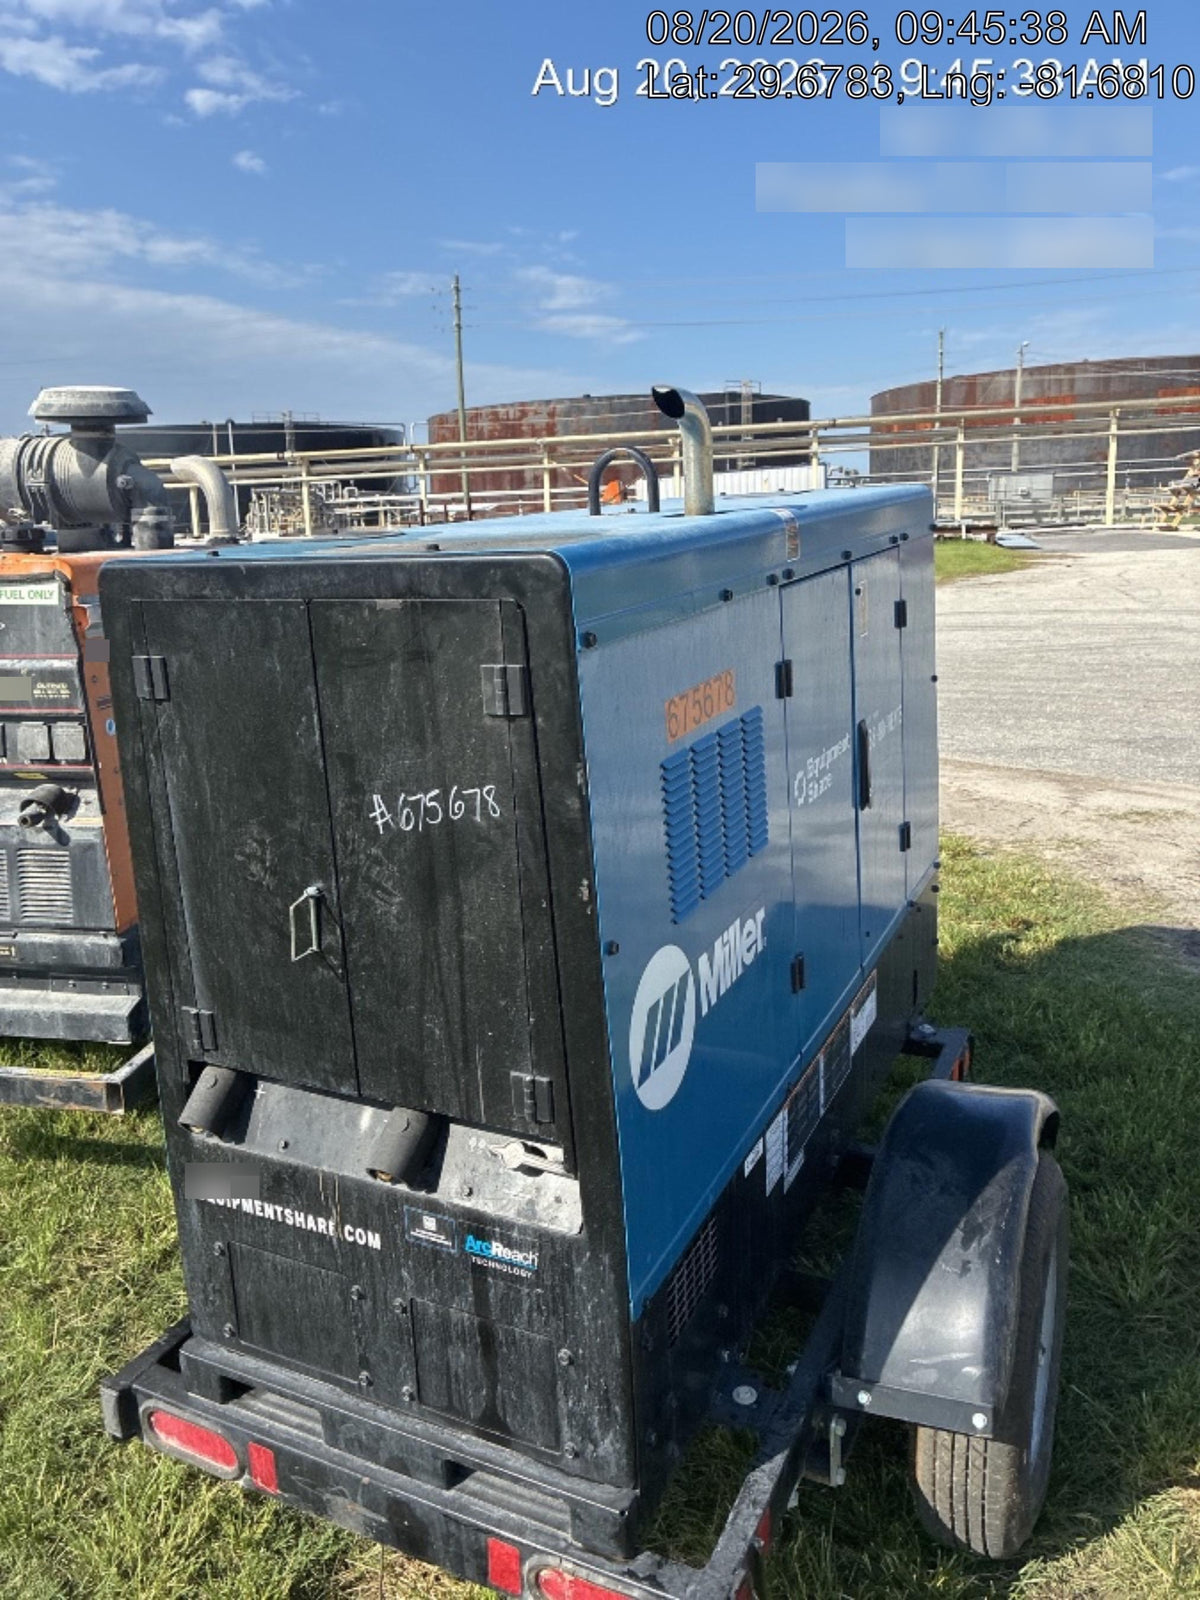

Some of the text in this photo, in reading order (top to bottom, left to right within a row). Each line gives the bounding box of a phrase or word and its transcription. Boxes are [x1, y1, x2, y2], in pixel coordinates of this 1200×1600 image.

[28, 589, 54, 600] ONLY
[667, 669, 735, 739] 675678
[698, 905, 766, 1018] Miller
[200, 1198, 382, 1250] IPMENTSHARECOM
[465, 1235, 538, 1267] ArcReach
[472, 1255, 533, 1279] TECHNOLOGY
